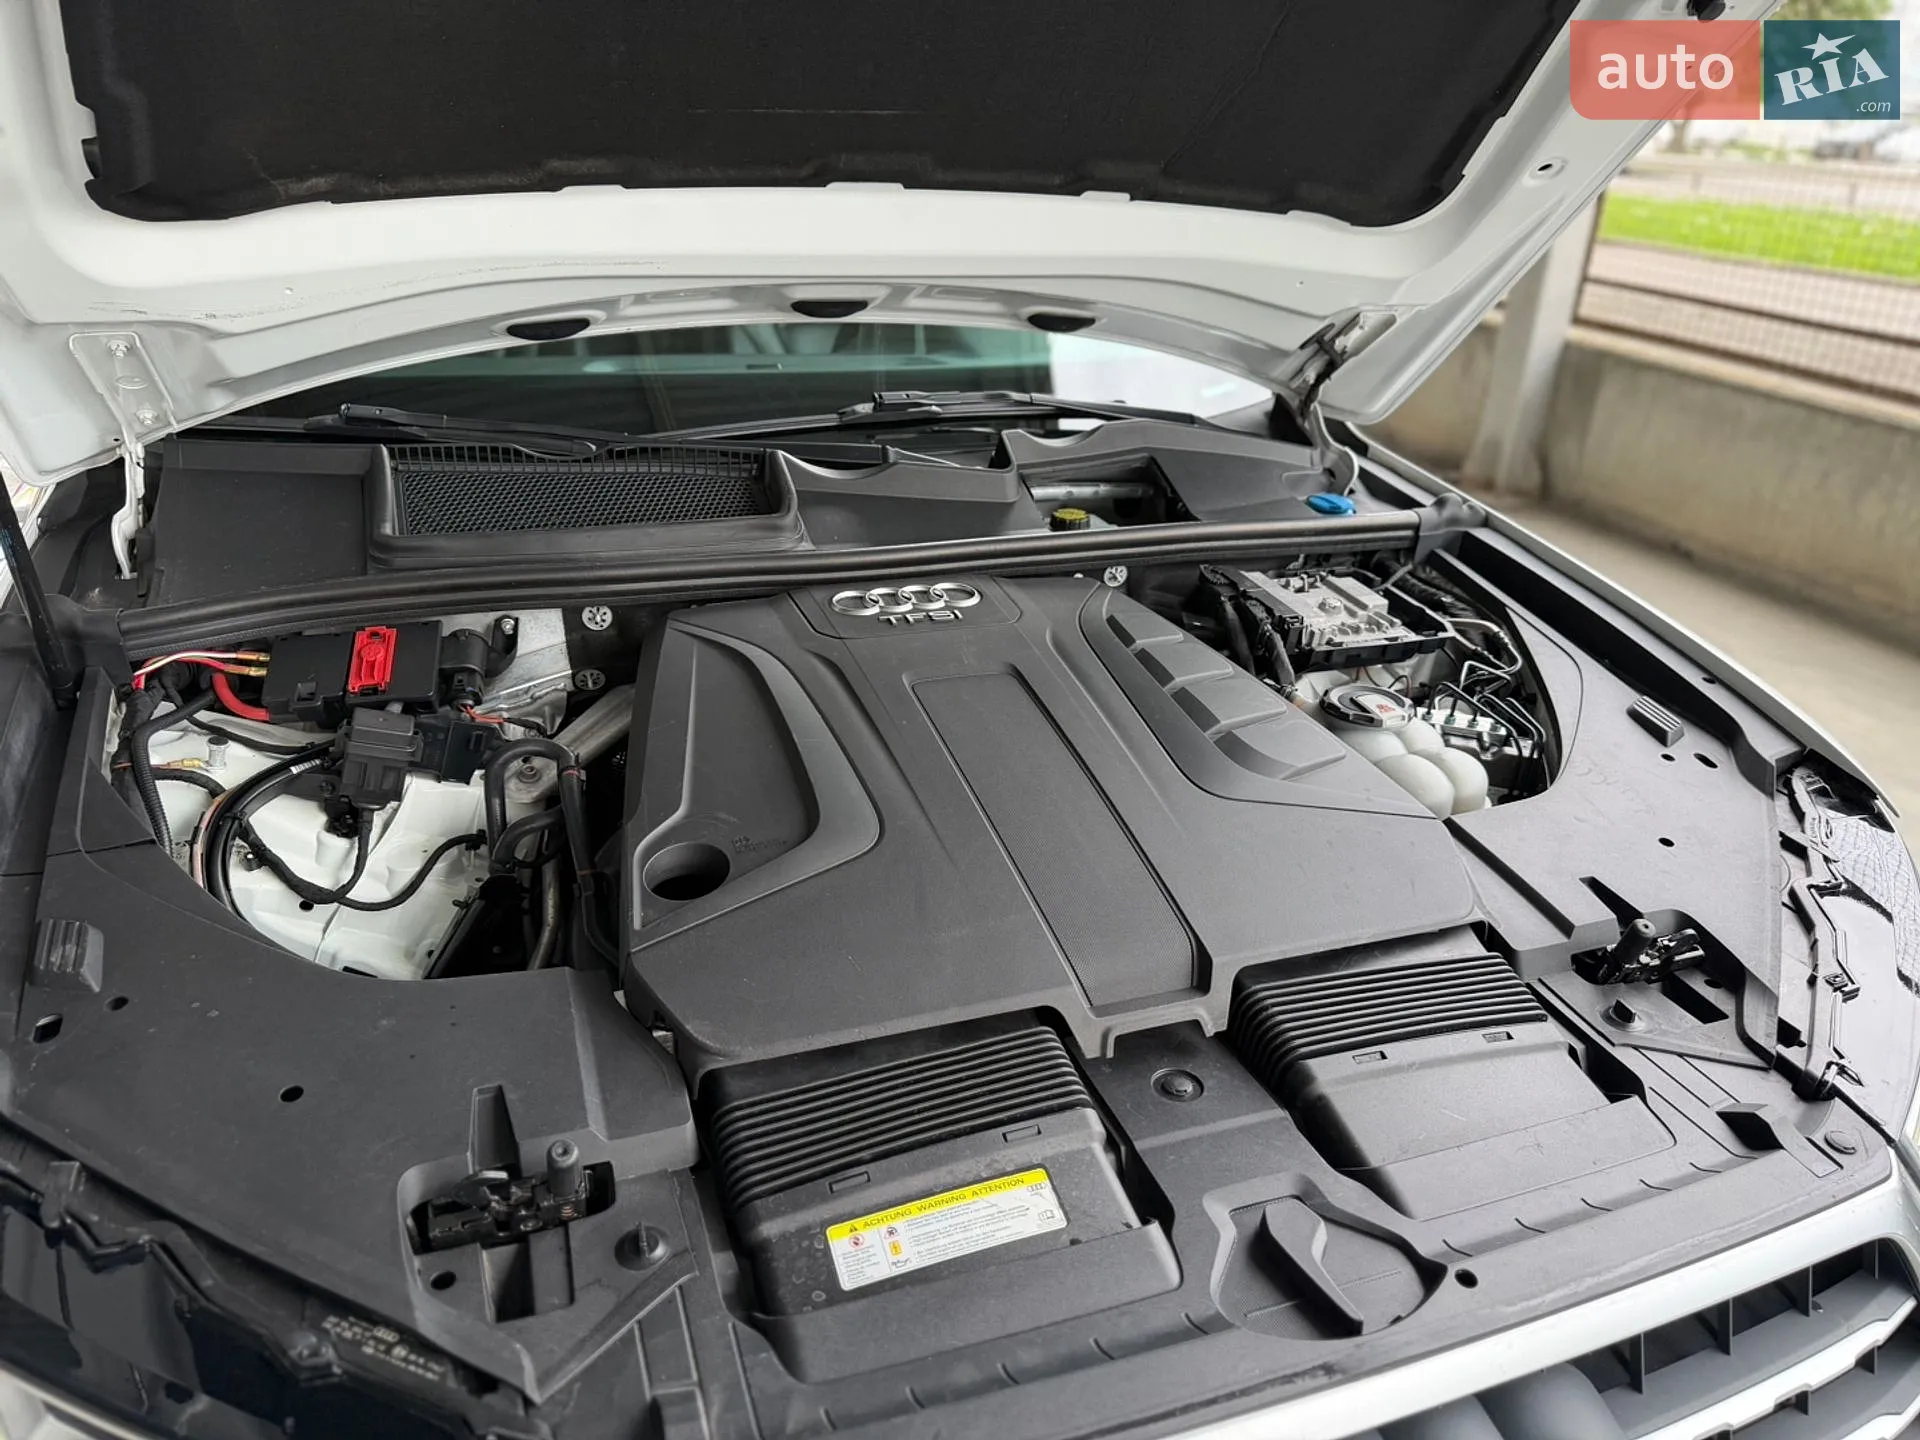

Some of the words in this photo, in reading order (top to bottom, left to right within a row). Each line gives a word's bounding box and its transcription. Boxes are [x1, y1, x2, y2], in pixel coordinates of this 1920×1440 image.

[878, 609, 964, 626] TFSI
[863, 1208, 912, 1230] ACHTUNG
[916, 1192, 967, 1213] WARNING
[971, 1177, 1025, 1198] ATTENTION
